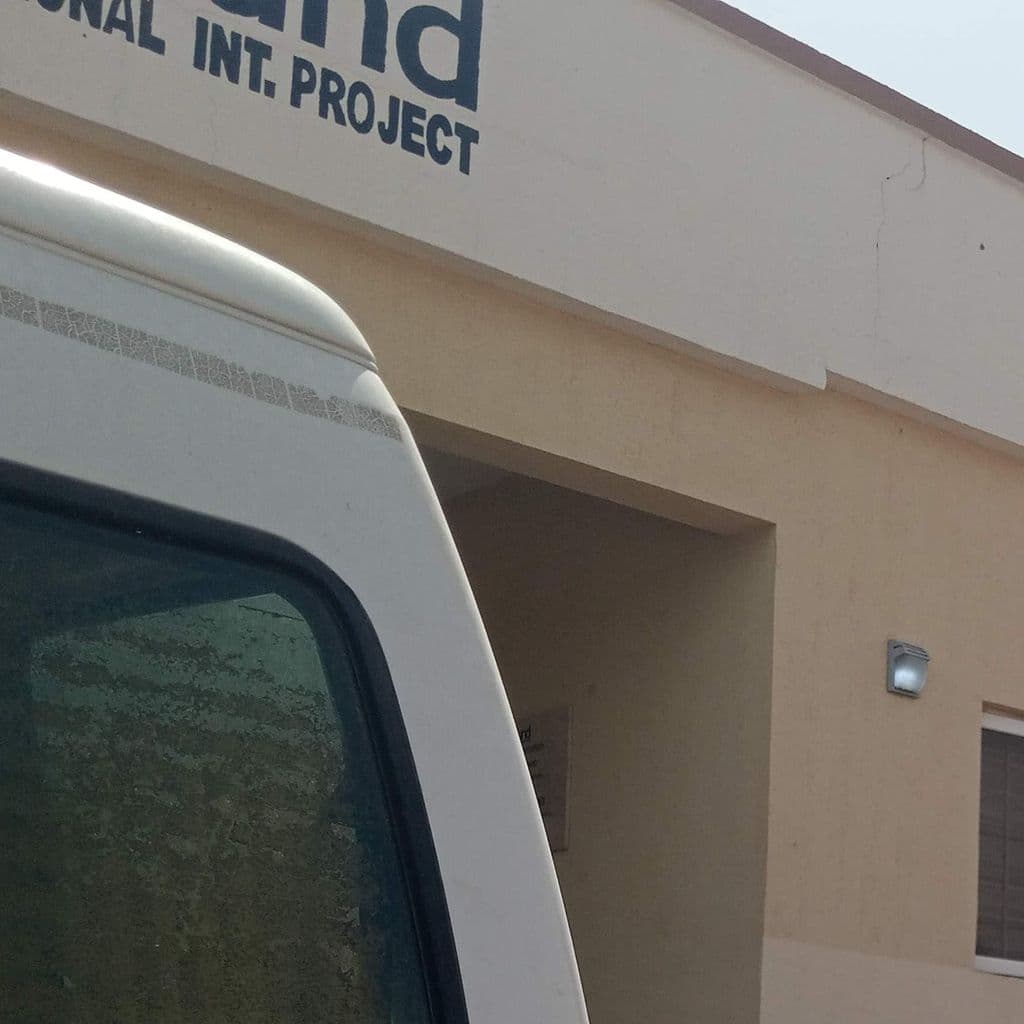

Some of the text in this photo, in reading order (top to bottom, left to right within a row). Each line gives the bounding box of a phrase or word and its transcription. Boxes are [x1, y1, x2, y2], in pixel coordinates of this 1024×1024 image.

[37, 0, 480, 176] AL INT. PROJECT
[210, 0, 483, 112] nd
